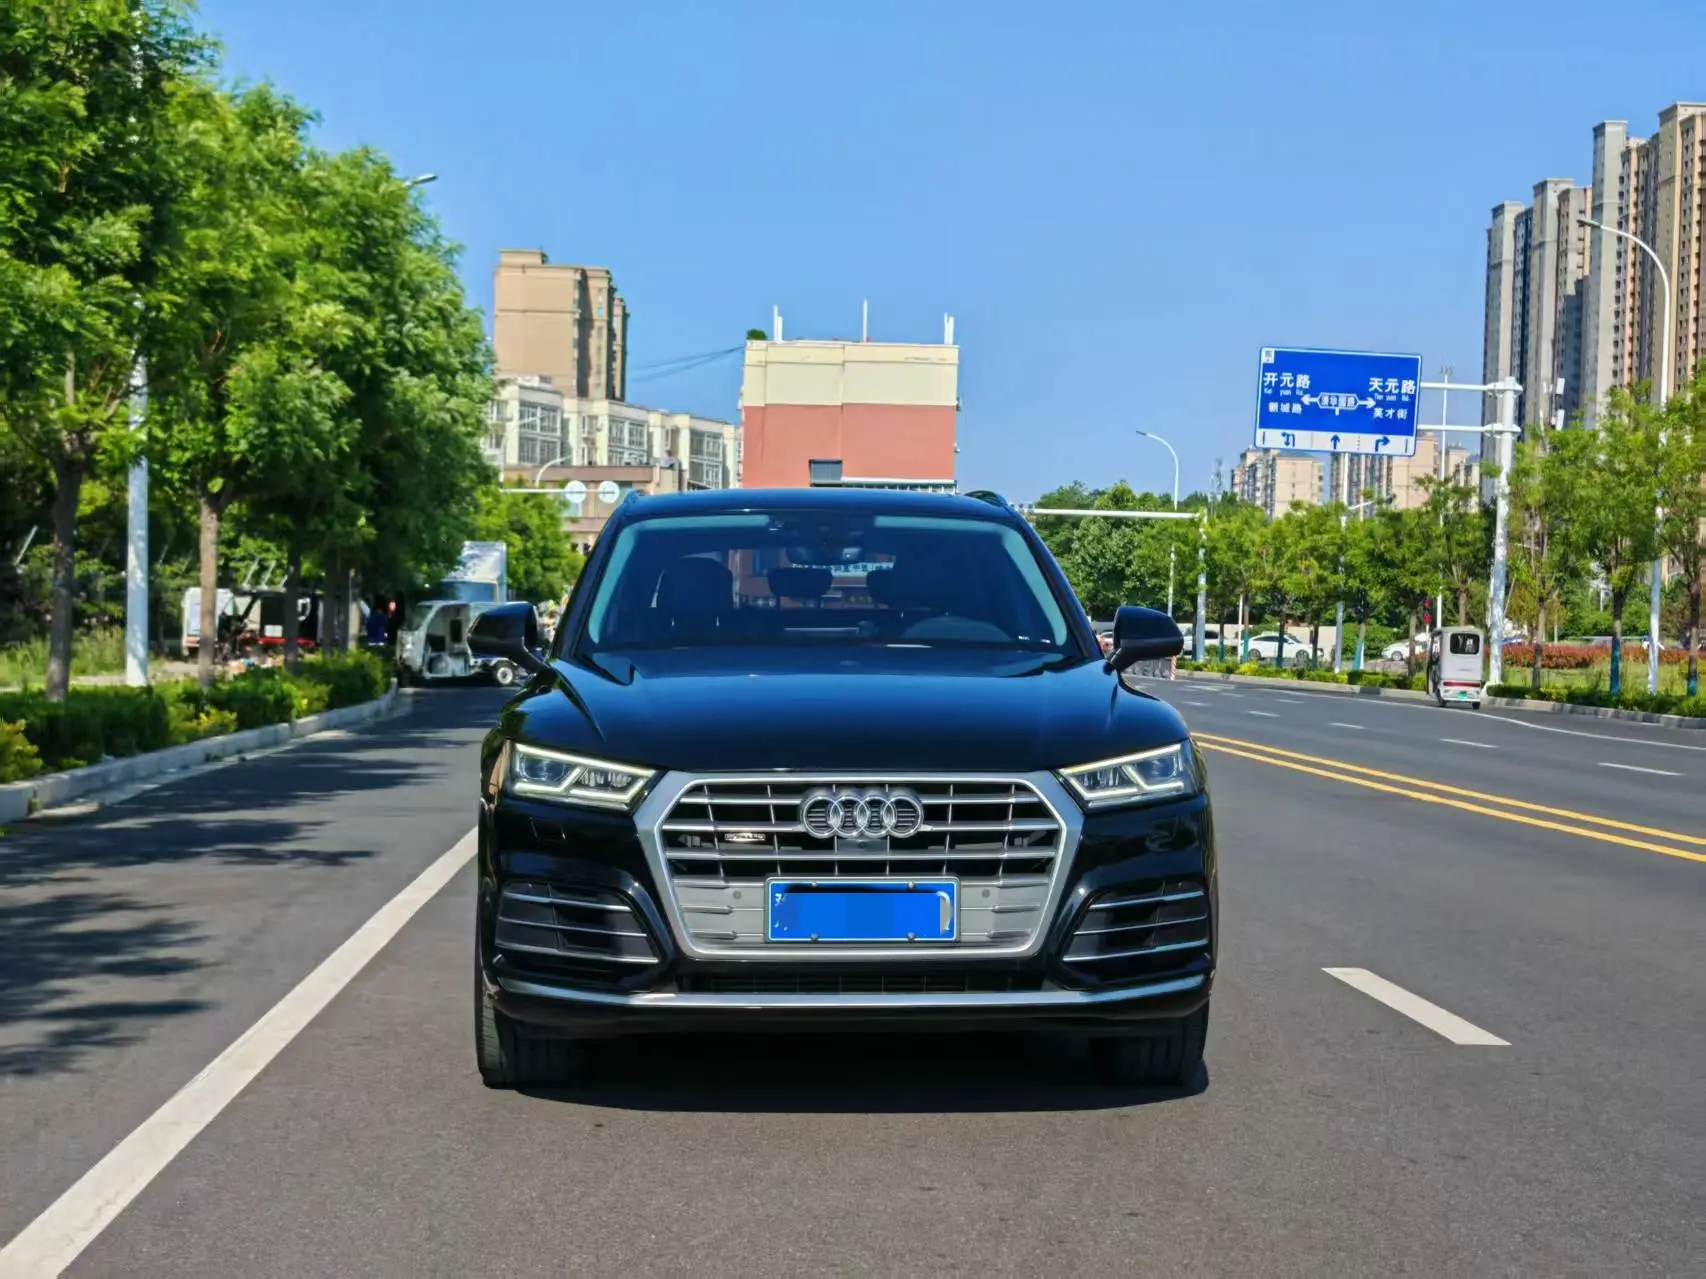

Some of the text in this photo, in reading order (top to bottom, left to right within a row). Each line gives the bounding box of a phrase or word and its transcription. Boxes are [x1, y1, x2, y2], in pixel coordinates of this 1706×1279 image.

[1264, 373, 1311, 389] 开元路
[1368, 378, 1415, 395] 天元路
